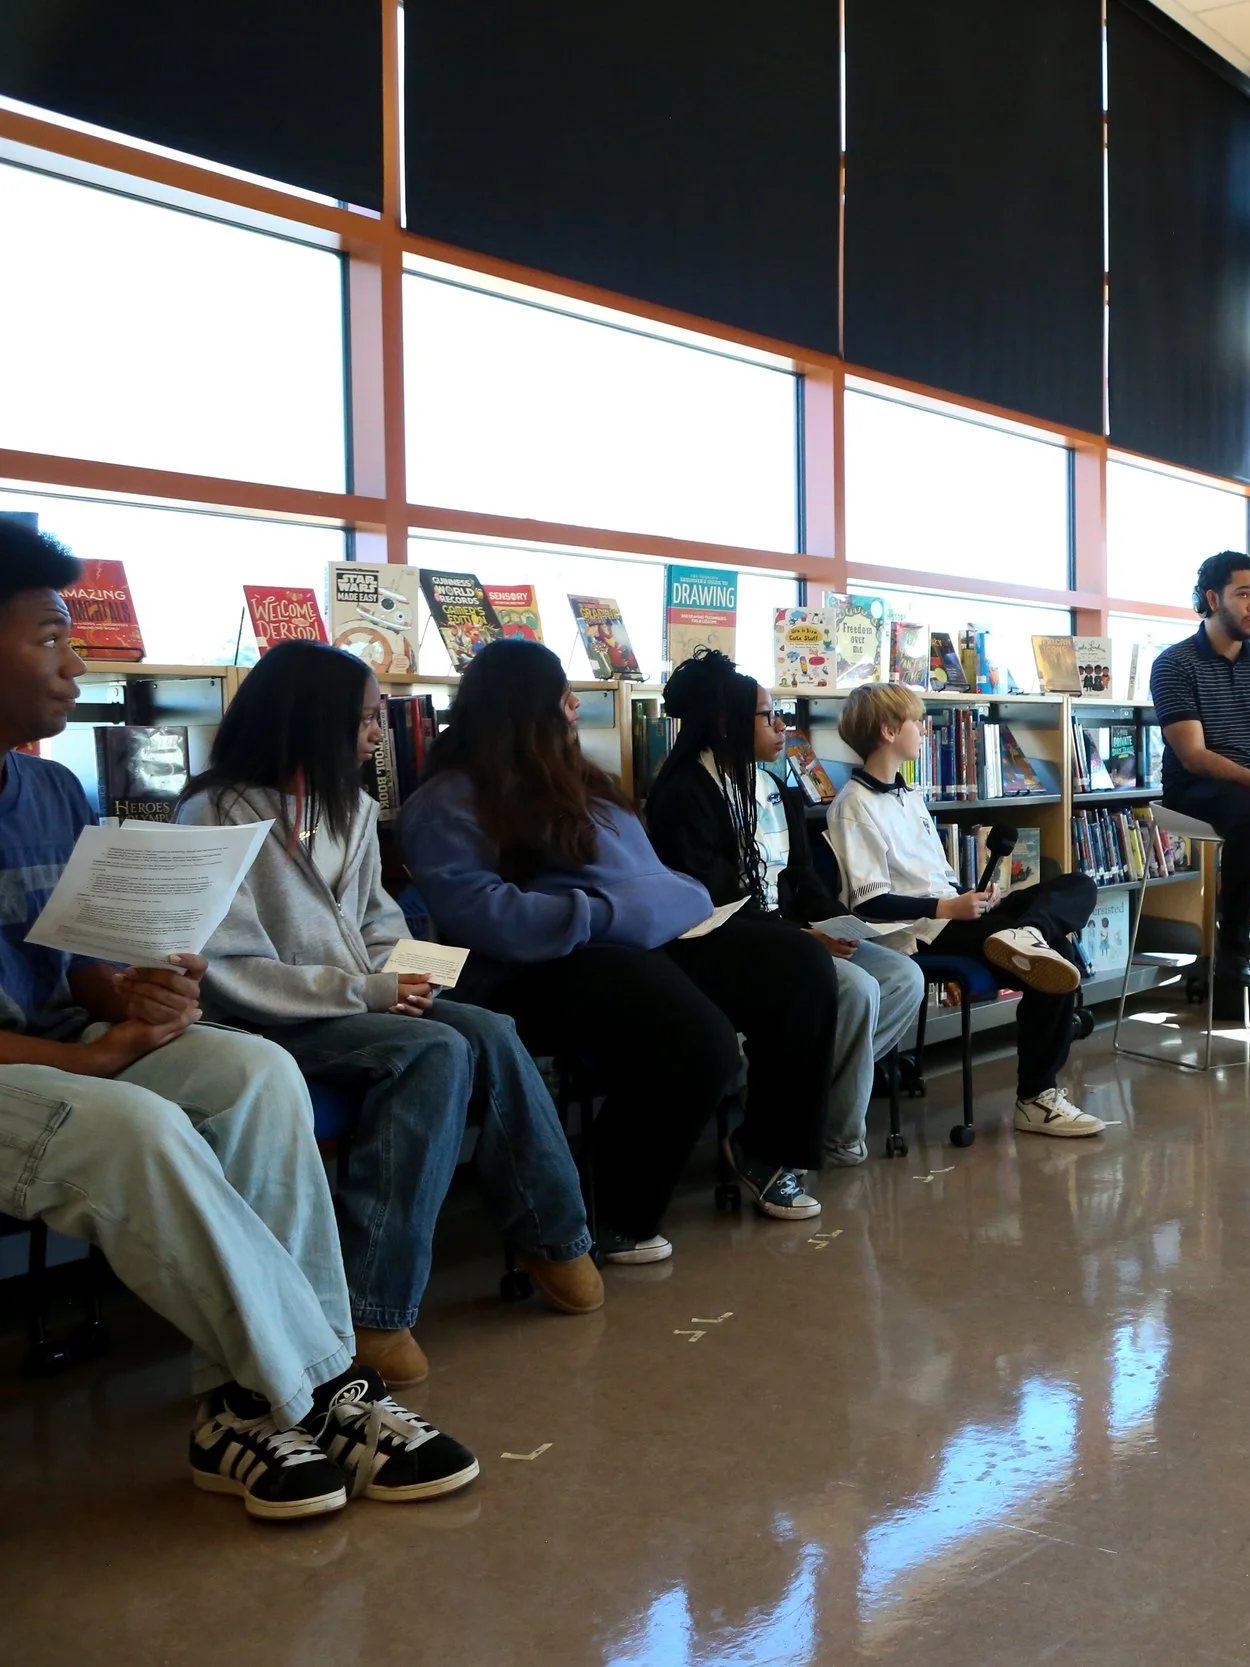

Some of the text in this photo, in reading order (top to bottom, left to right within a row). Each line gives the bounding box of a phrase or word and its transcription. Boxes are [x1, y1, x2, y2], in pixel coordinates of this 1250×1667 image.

[337, 574, 378, 584] STAR
[432, 576, 473, 587] GUINNESS
[337, 582, 378, 593] WARS
[434, 585, 475, 597] WORLD
[337, 592, 378, 602] MADE EASY
[439, 595, 480, 605] RECORDS
[488, 591, 528, 601] SENSORY
[673, 582, 735, 608] DRAWING
[251, 596, 317, 622] WELCOME
[842, 622, 873, 634] Freedom
[376, 777, 391, 810] BOOK
[114, 800, 171, 815] HEROES
[1092, 901, 1125, 917] ersisted
